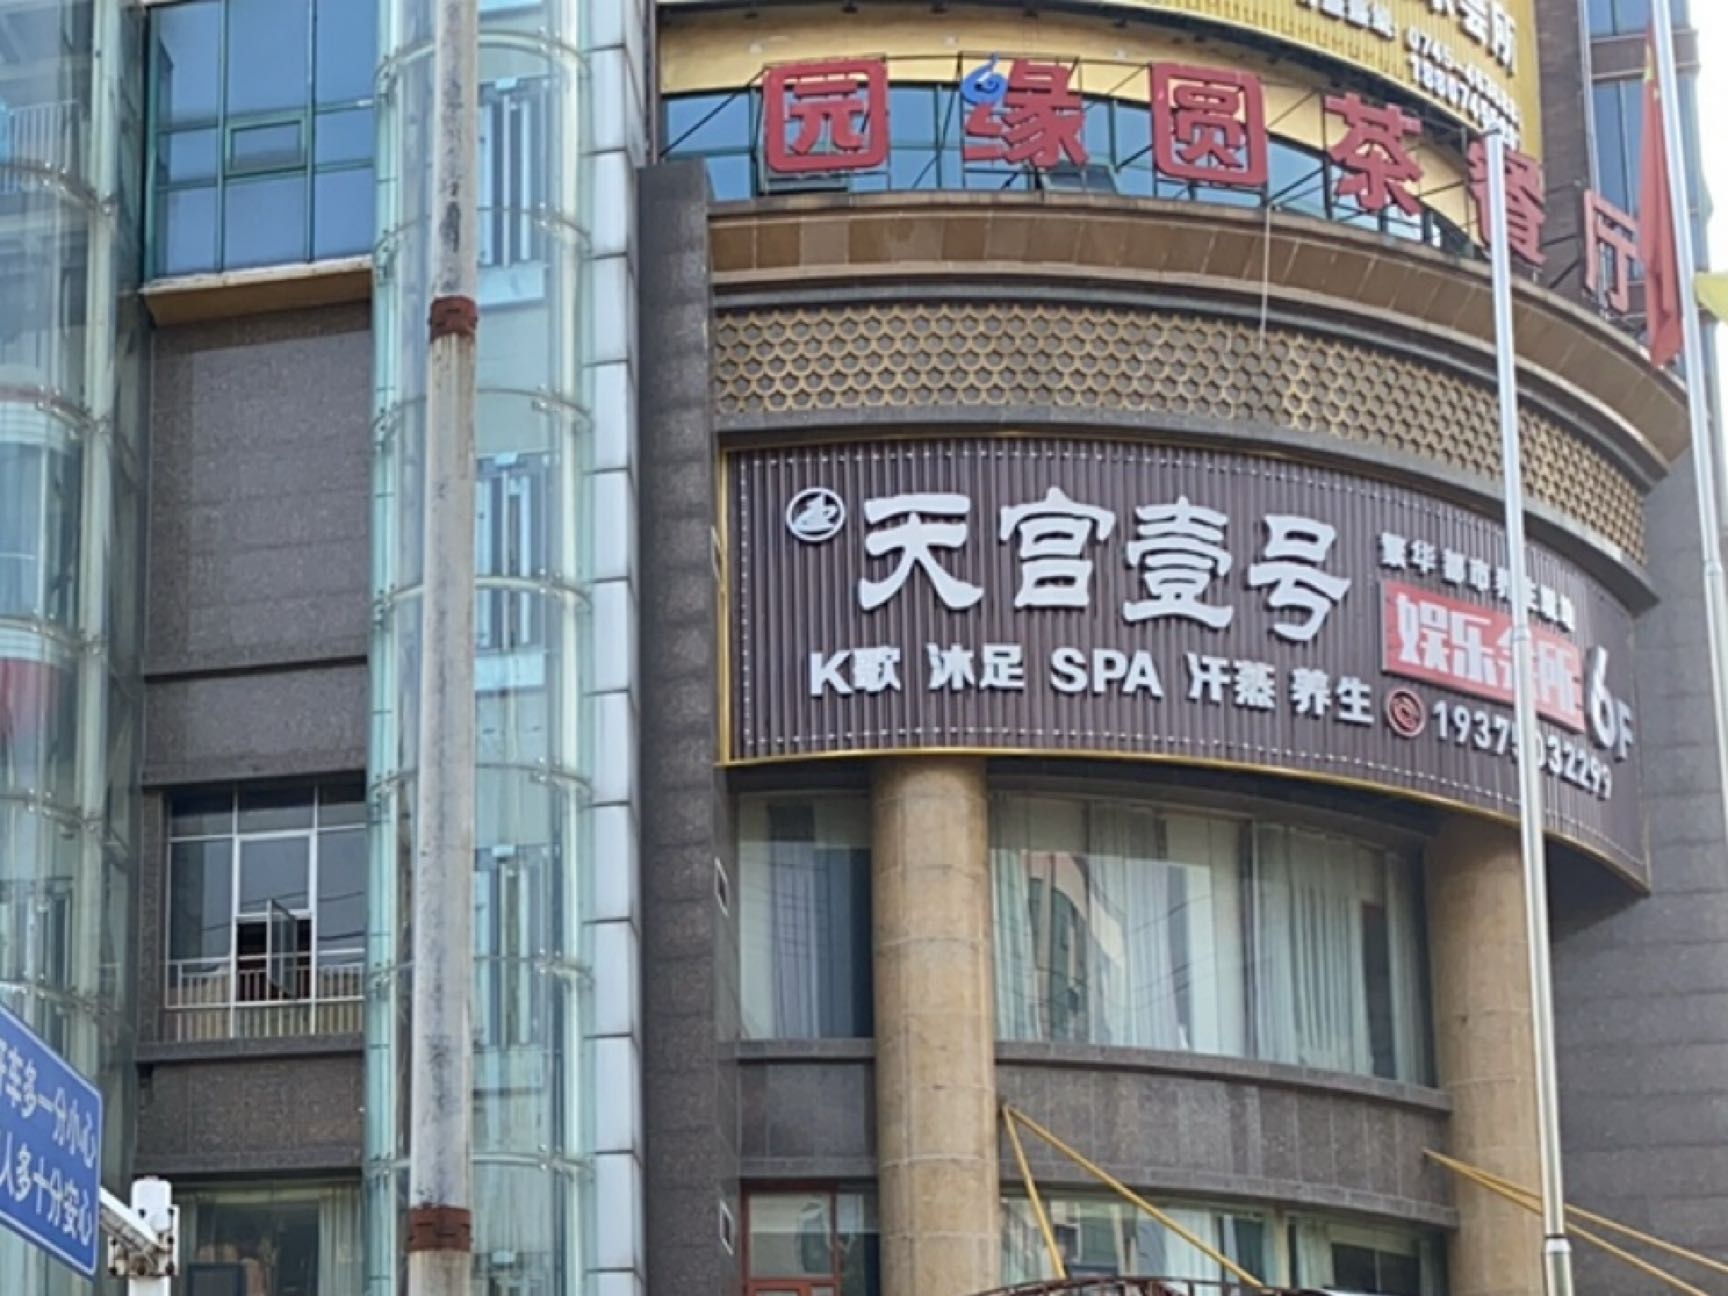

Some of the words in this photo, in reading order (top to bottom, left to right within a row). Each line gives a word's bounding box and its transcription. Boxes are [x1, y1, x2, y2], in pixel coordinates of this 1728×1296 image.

[762, 56, 1644, 314] 园缘圆茶餐厅
[859, 486, 1352, 643] 天宫壹号
[809, 644, 902, 697] K歌
[927, 642, 1025, 692] 沐足
[1050, 648, 1164, 698] SPA
[1186, 652, 1277, 710] 汗蒸
[1290, 667, 1375, 724] 养生
[1587, 644, 1634, 763] 6F
[1432, 699, 1613, 801] 1937032299
